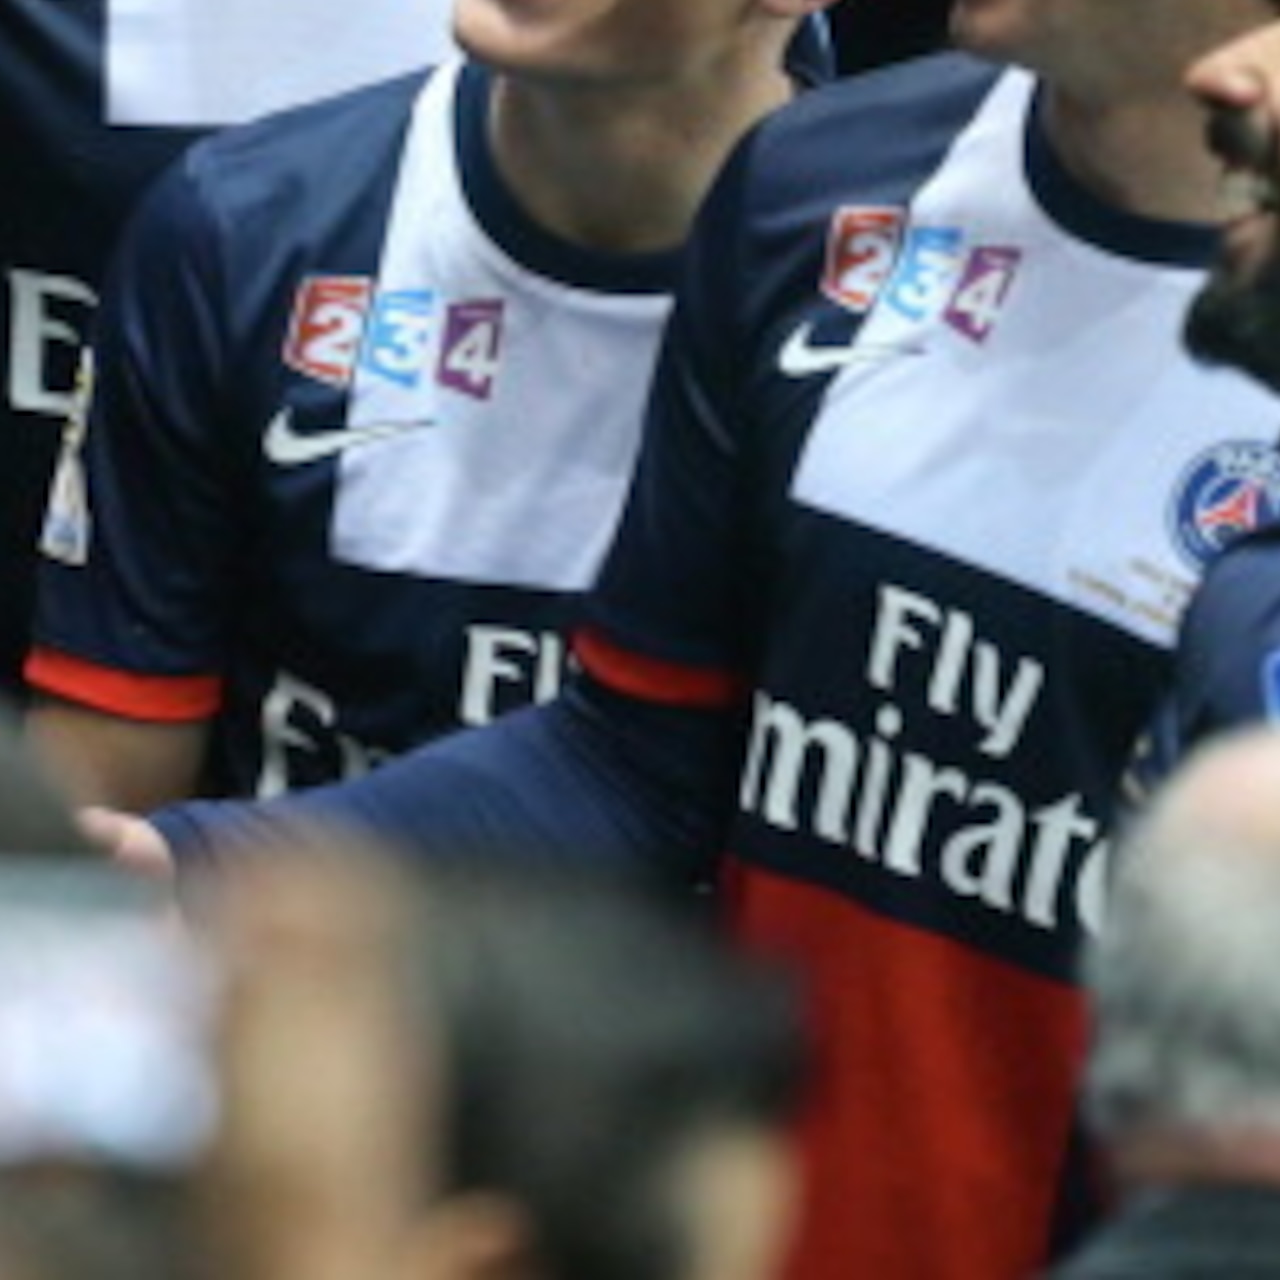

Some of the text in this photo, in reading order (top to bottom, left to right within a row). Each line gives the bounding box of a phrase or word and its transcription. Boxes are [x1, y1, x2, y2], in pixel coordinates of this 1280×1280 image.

[445, 321, 499, 385] 4
[461, 622, 582, 726] Fl
[865, 582, 1046, 760] Fly
